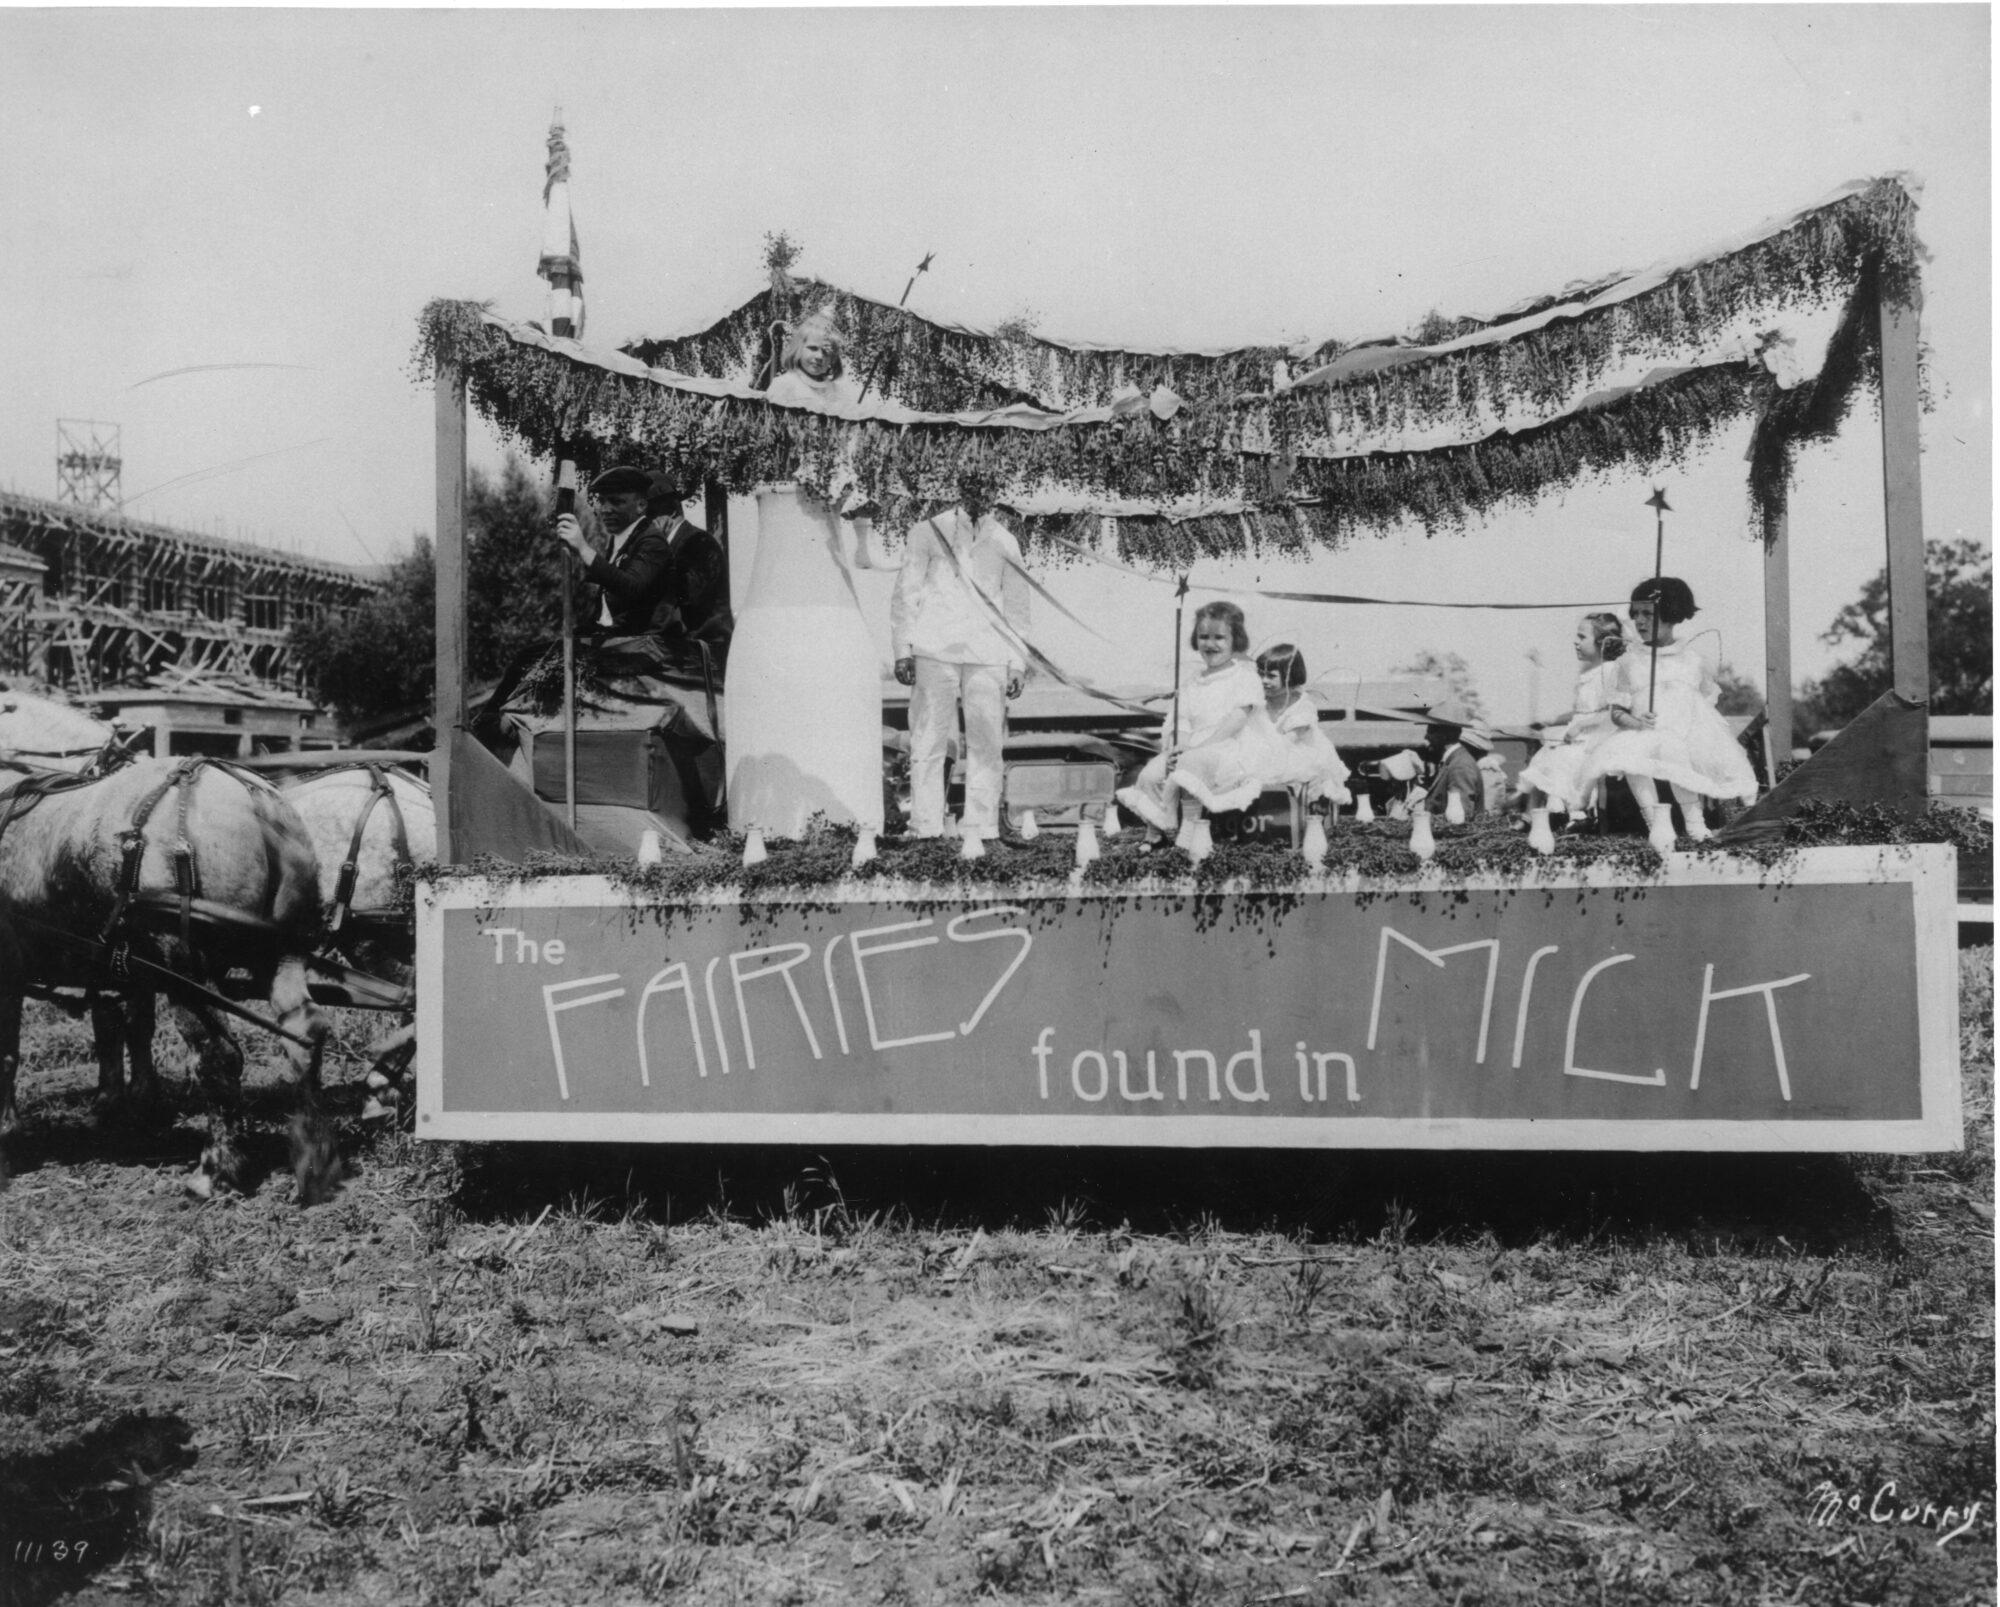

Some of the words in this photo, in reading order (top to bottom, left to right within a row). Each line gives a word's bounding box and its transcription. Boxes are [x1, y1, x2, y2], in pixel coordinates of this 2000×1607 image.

[483, 928, 566, 965] The
[543, 905, 1032, 1100] FAIRIES
[1031, 1028, 1269, 1102] found
[1295, 1041, 1361, 1102] in
